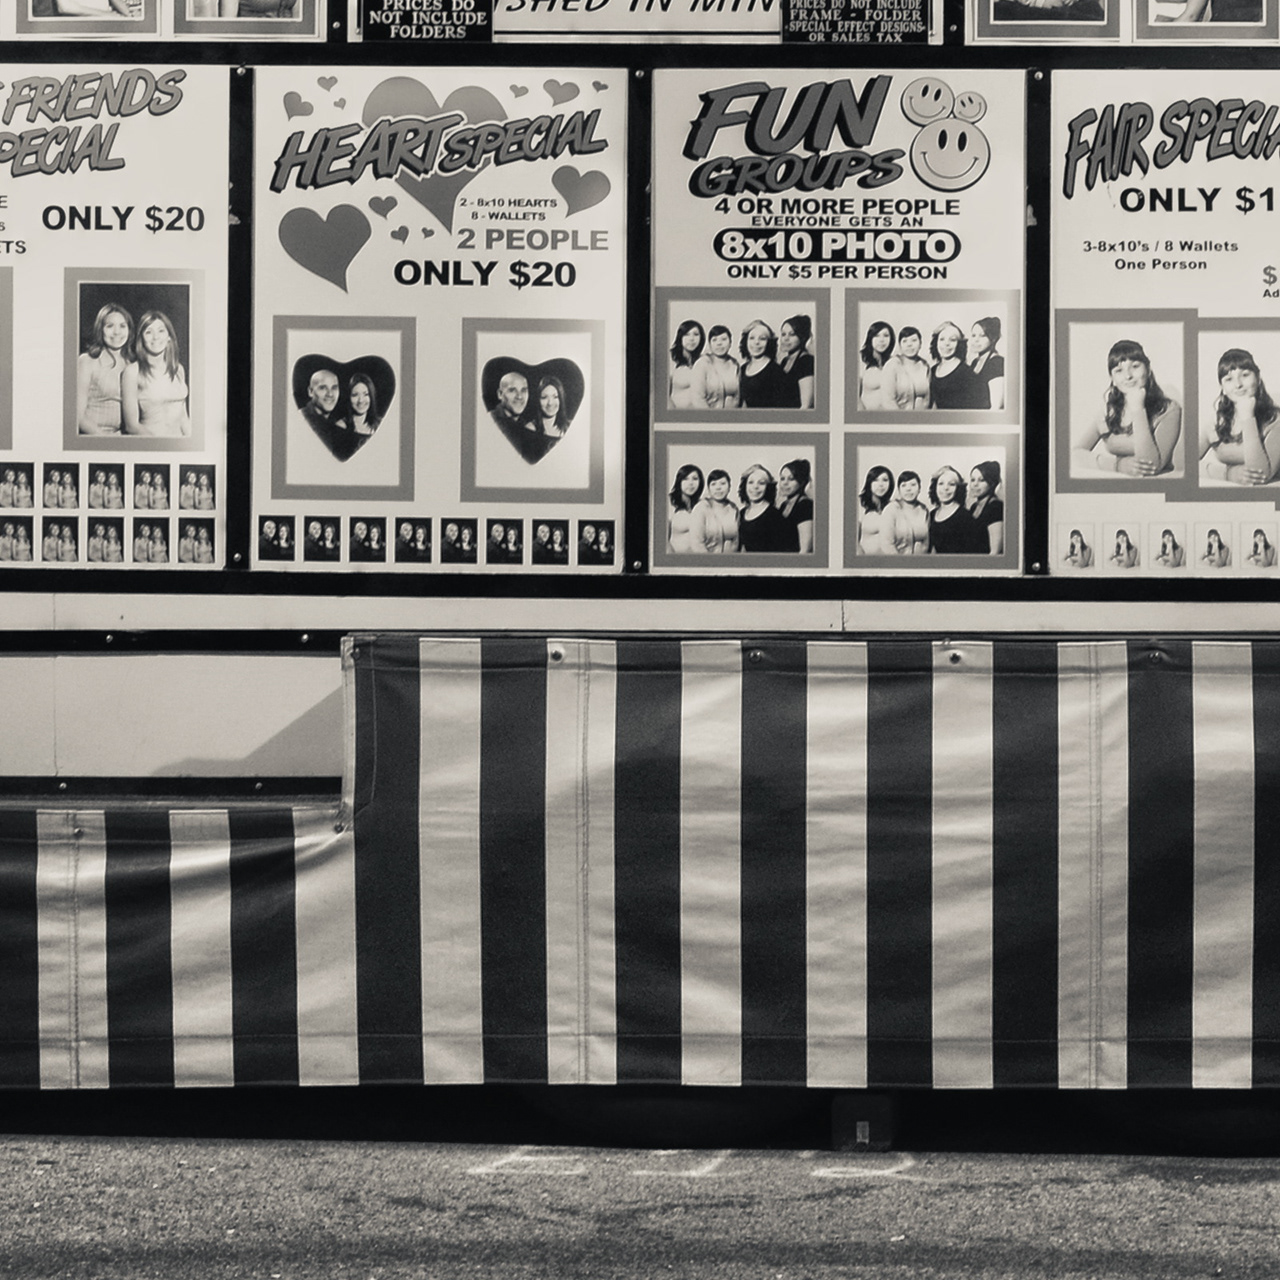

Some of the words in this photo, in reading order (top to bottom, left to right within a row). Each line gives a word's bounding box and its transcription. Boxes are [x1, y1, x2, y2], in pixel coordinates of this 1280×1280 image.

[369, 11, 403, 24] NOT
[412, 11, 487, 25] INCLUDE
[790, 9, 842, 20] FRAME
[865, 9, 922, 21] FOLDER
[390, 25, 467, 38] FOLDERS
[838, 21, 875, 32] EFFECT
[809, 33, 825, 42] OR
[832, 33, 870, 42] SALES
[877, 33, 903, 42] TAX
[1, 68, 187, 125] FRIENDS
[682, 74, 894, 162] FUN
[1062, 101, 1154, 200] FAIR
[688, 148, 906, 198] GROUPS
[459, 197, 468, 208] 2
[476, 197, 505, 208] 8x10
[508, 197, 558, 208] HEARTS
[714, 198, 731, 215] 4
[737, 198, 775, 215] OR
[781, 198, 855, 215] MORE
[862, 198, 961, 216] PEOPLE
[1120, 187, 1222, 213] ONLY
[41, 205, 134, 231] ONLY
[144, 204, 206, 234] $20
[471, 211, 479, 221] 8
[488, 211, 546, 221] WALLETS
[751, 215, 841, 227] EVERYONE
[848, 215, 893, 227] GETS
[900, 216, 924, 227] AN
[456, 227, 476, 250] 2
[485, 228, 609, 251] PEOPLE
[721, 231, 813, 260] 8x10
[822, 231, 956, 261] PHOTO
[1164, 240, 1174, 252] 8
[1179, 240, 1239, 252] Wallets
[727, 265, 783, 280] ONLY
[788, 264, 812, 282] $5
[818, 265, 858, 280] PER
[864, 265, 948, 280] PERSON
[1114, 258, 1147, 270] One
[1152, 258, 1207, 270] Person
[393, 259, 499, 287] ONLY
[508, 259, 577, 291] $20
